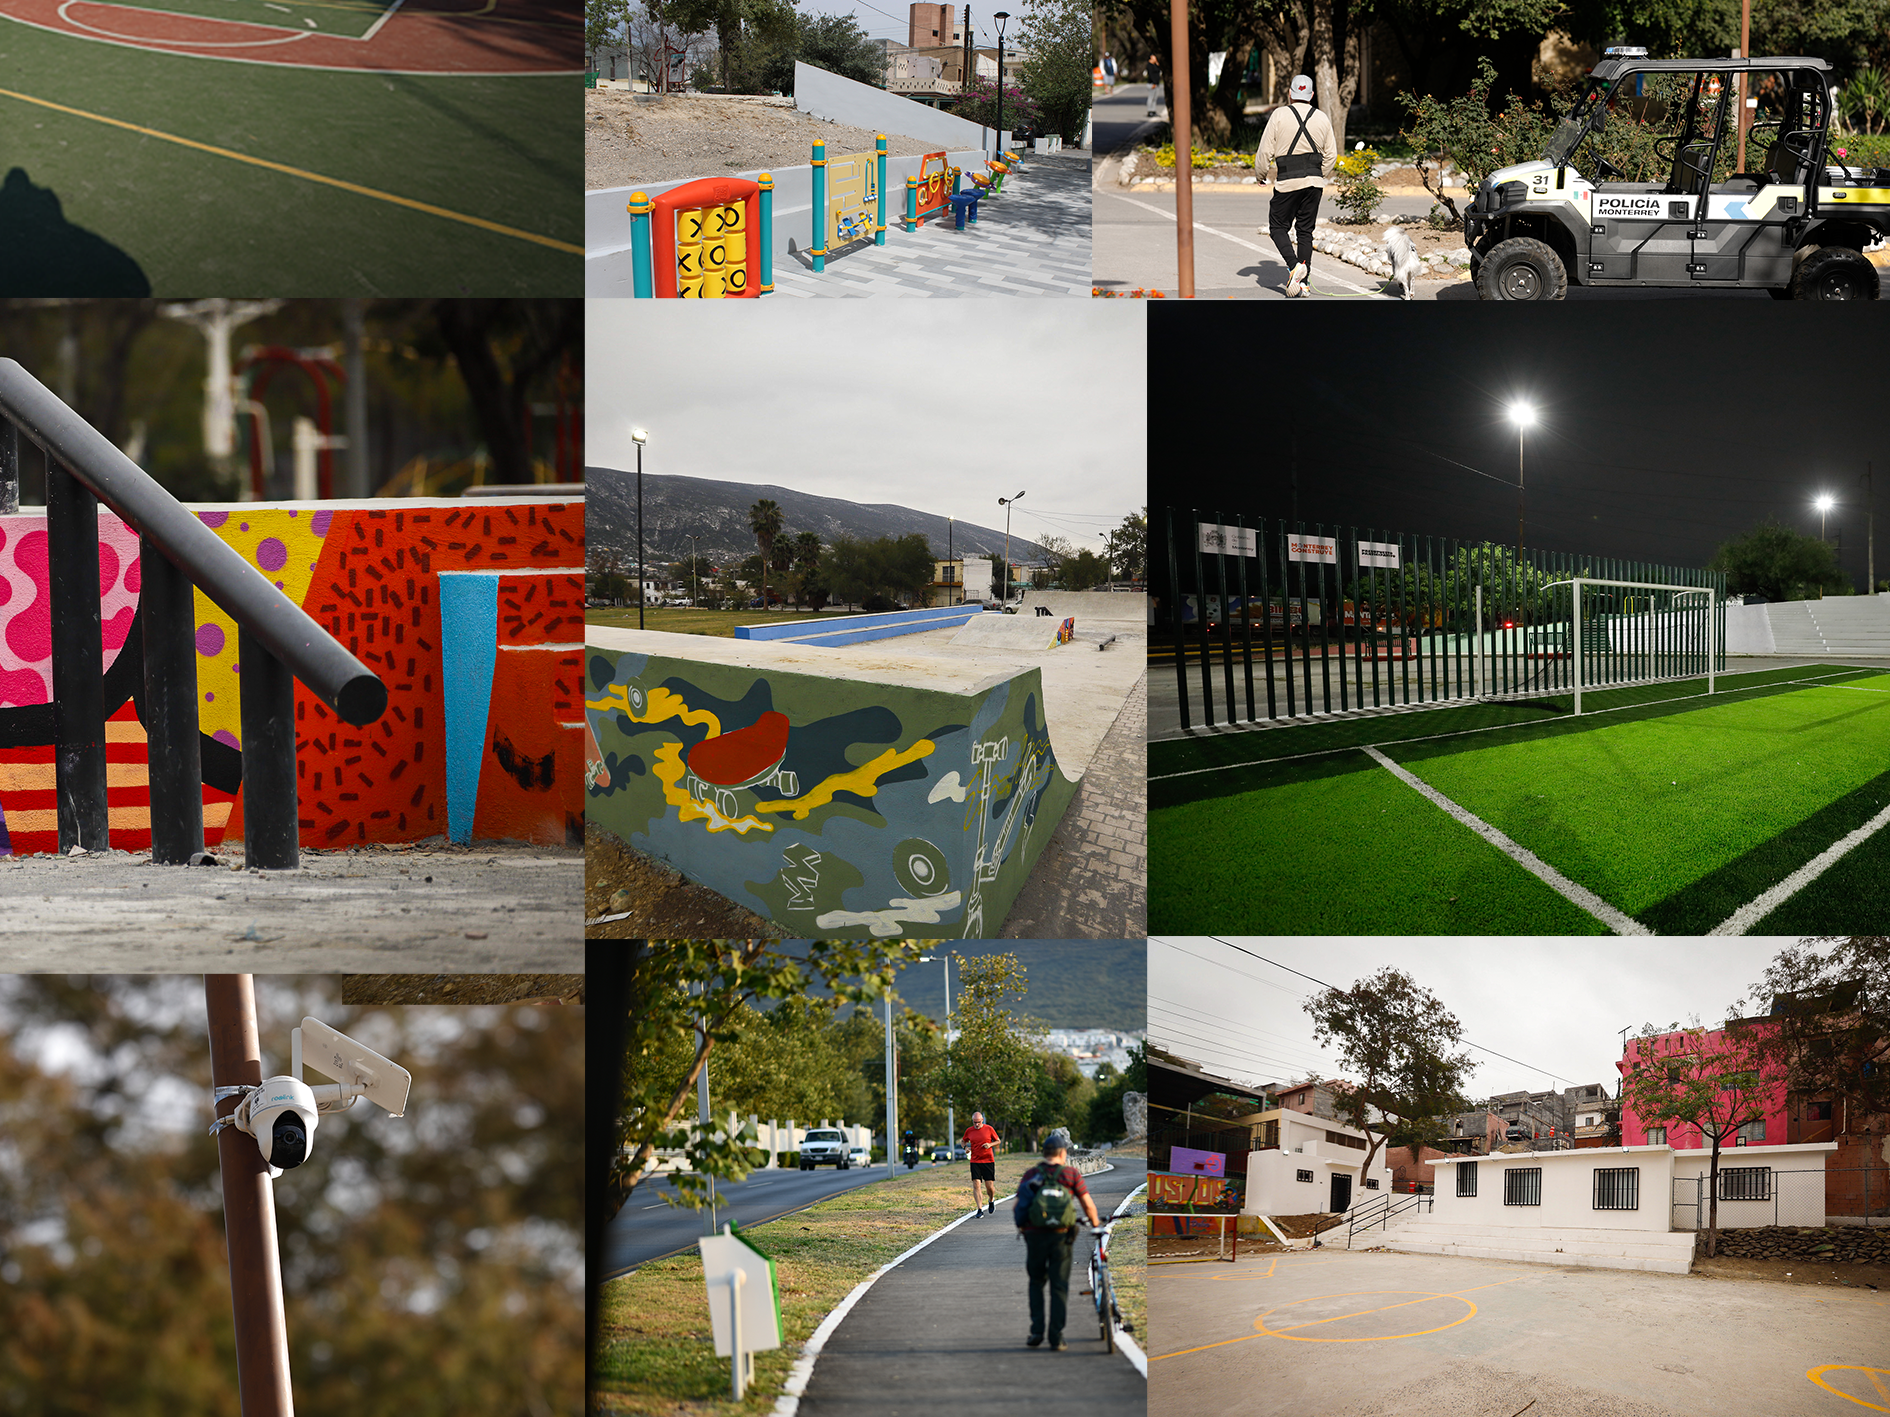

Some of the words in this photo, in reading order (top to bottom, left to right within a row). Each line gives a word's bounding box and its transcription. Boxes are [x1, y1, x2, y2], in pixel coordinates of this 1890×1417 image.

[1532, 175, 1549, 185] 31
[1599, 197, 1660, 209] POLICÍA
[1598, 208, 1660, 216] MONTERREY
[1291, 542, 1334, 551] MONTERREY
[1291, 547, 1333, 556] CONSTRUYE
